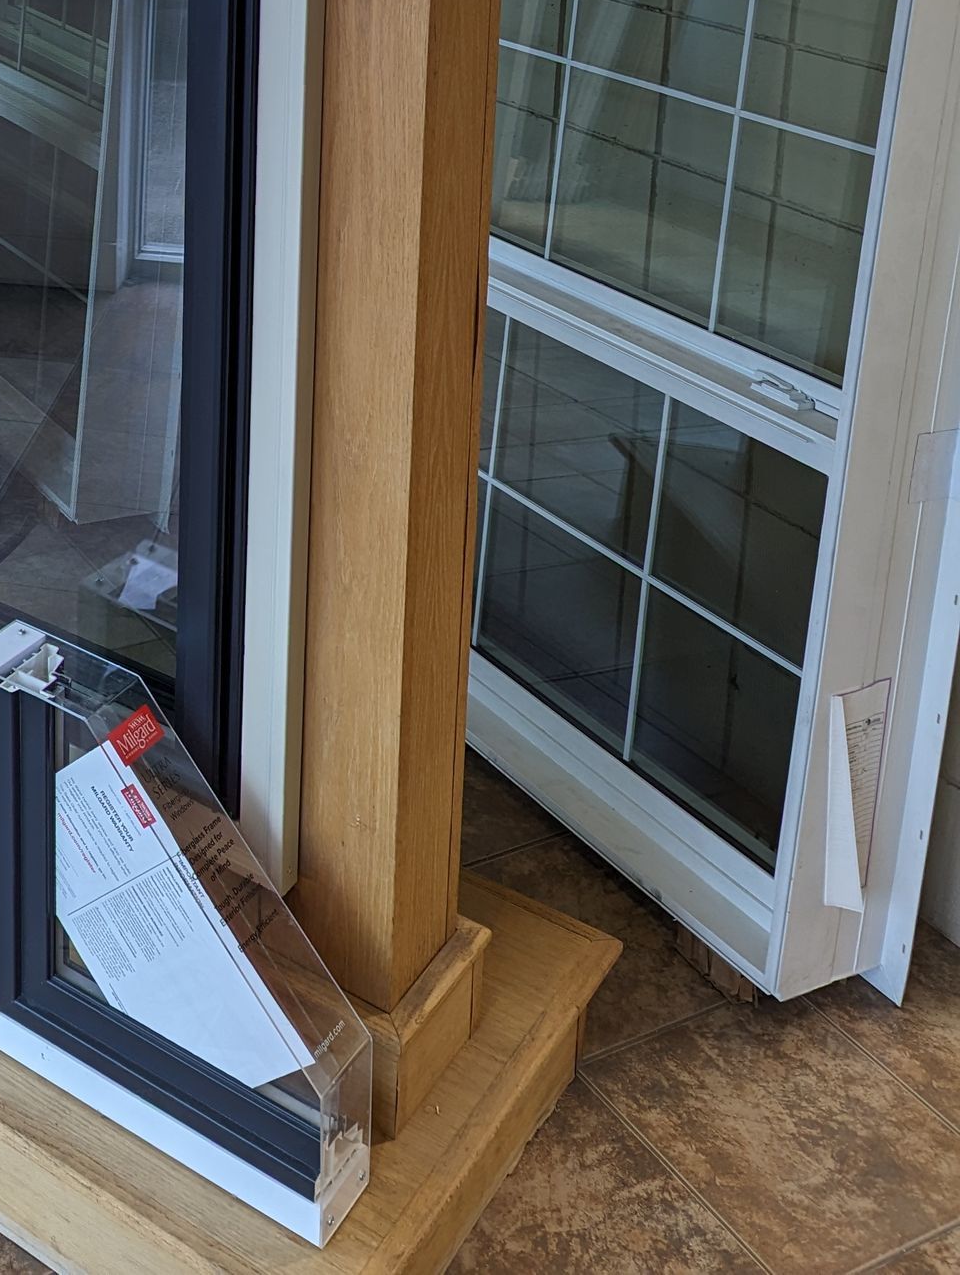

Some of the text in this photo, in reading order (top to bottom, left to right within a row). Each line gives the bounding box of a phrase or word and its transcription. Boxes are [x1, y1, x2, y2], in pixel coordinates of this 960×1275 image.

[116, 713, 156, 756] Milgard
[152, 772, 182, 800] SERIES
[90, 785, 111, 815] MILGARD
[108, 815, 134, 853] WARRANTY
[99, 790, 122, 822] REGISTER
[120, 823, 134, 842] YOUR
[170, 799, 195, 822] Windows
[203, 815, 222, 839] Frame
[189, 831, 224, 866] Designed for
[216, 837, 236, 861] Peace
[178, 859, 205, 898] IMPORTANT
[210, 858, 232, 883] of Mind
[313, 1020, 346, 1059] milgard.com
